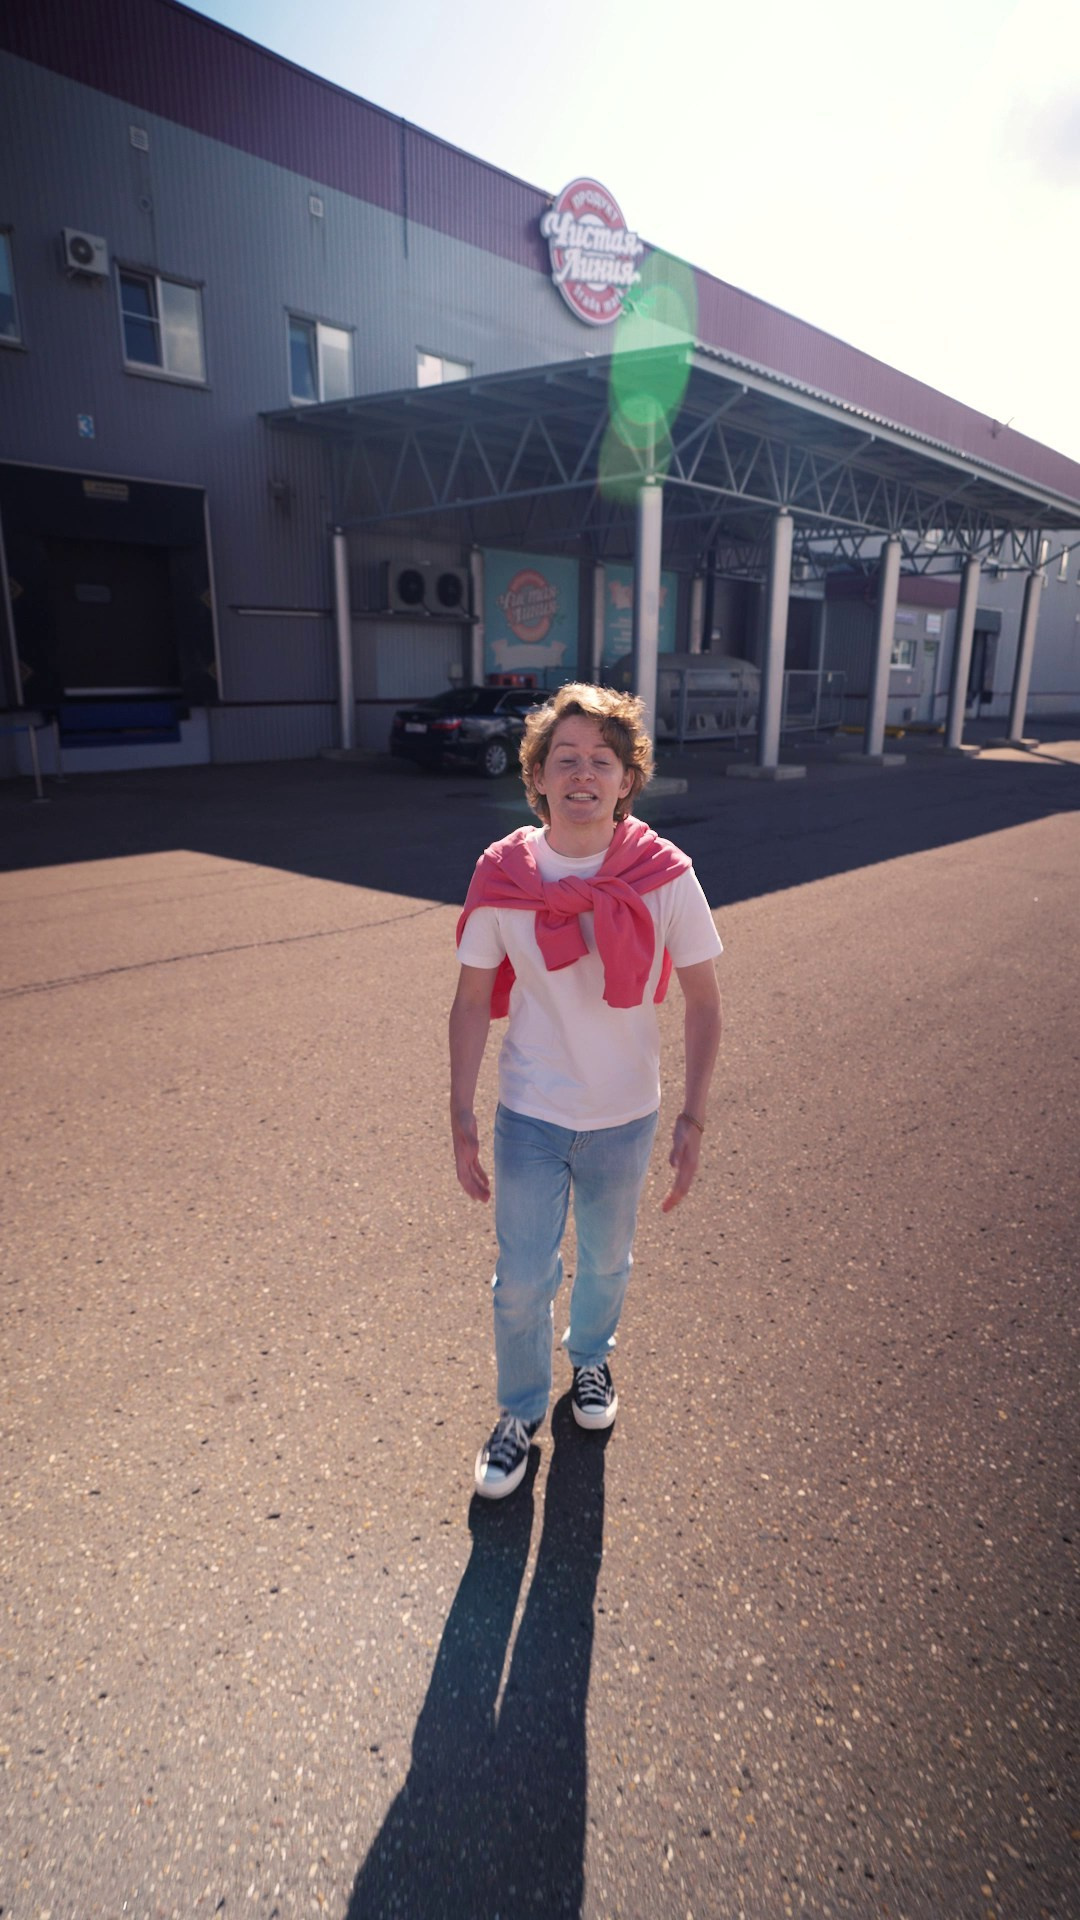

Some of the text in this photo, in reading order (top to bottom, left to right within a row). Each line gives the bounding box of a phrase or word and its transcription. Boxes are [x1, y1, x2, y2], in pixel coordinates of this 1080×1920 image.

[544, 212, 644, 255] Чистая
[556, 248, 641, 285] Линия
[80, 415, 93, 437] 3
